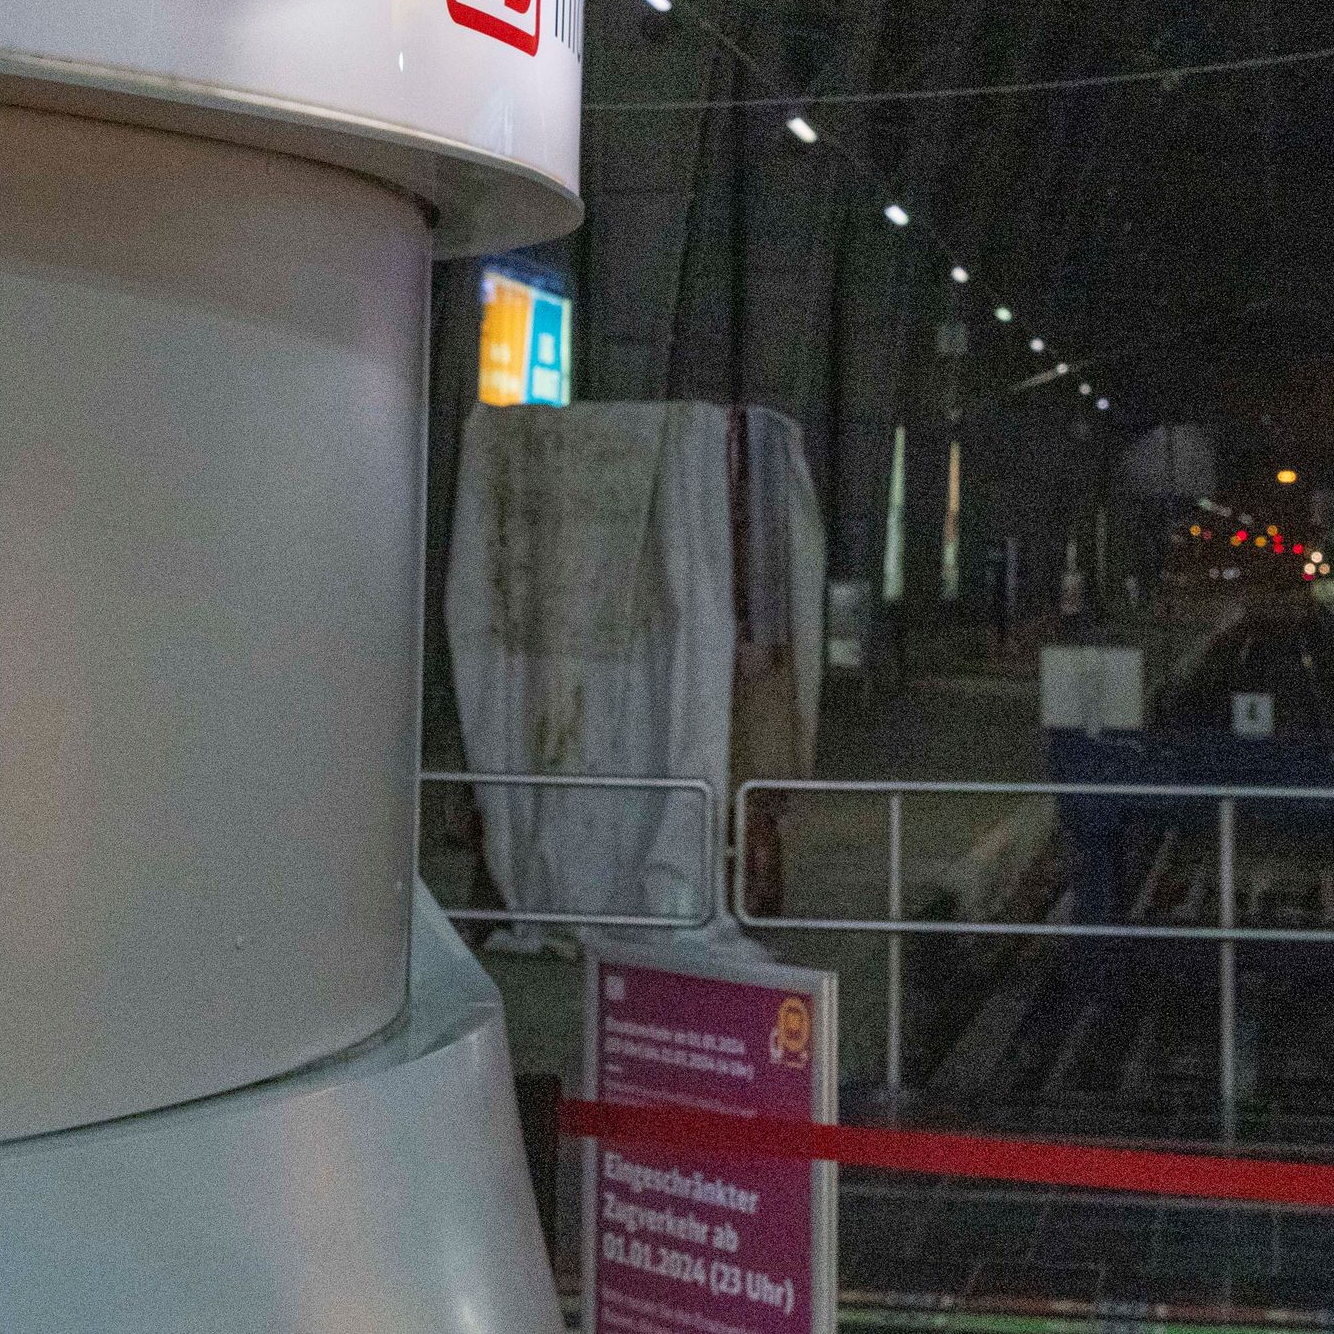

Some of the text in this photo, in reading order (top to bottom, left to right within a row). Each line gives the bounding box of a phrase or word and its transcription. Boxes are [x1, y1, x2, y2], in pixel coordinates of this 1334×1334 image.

[712, 1222, 739, 1253] ab
[710, 1261, 742, 1295] (23
[745, 1270, 794, 1315] Uhr)
